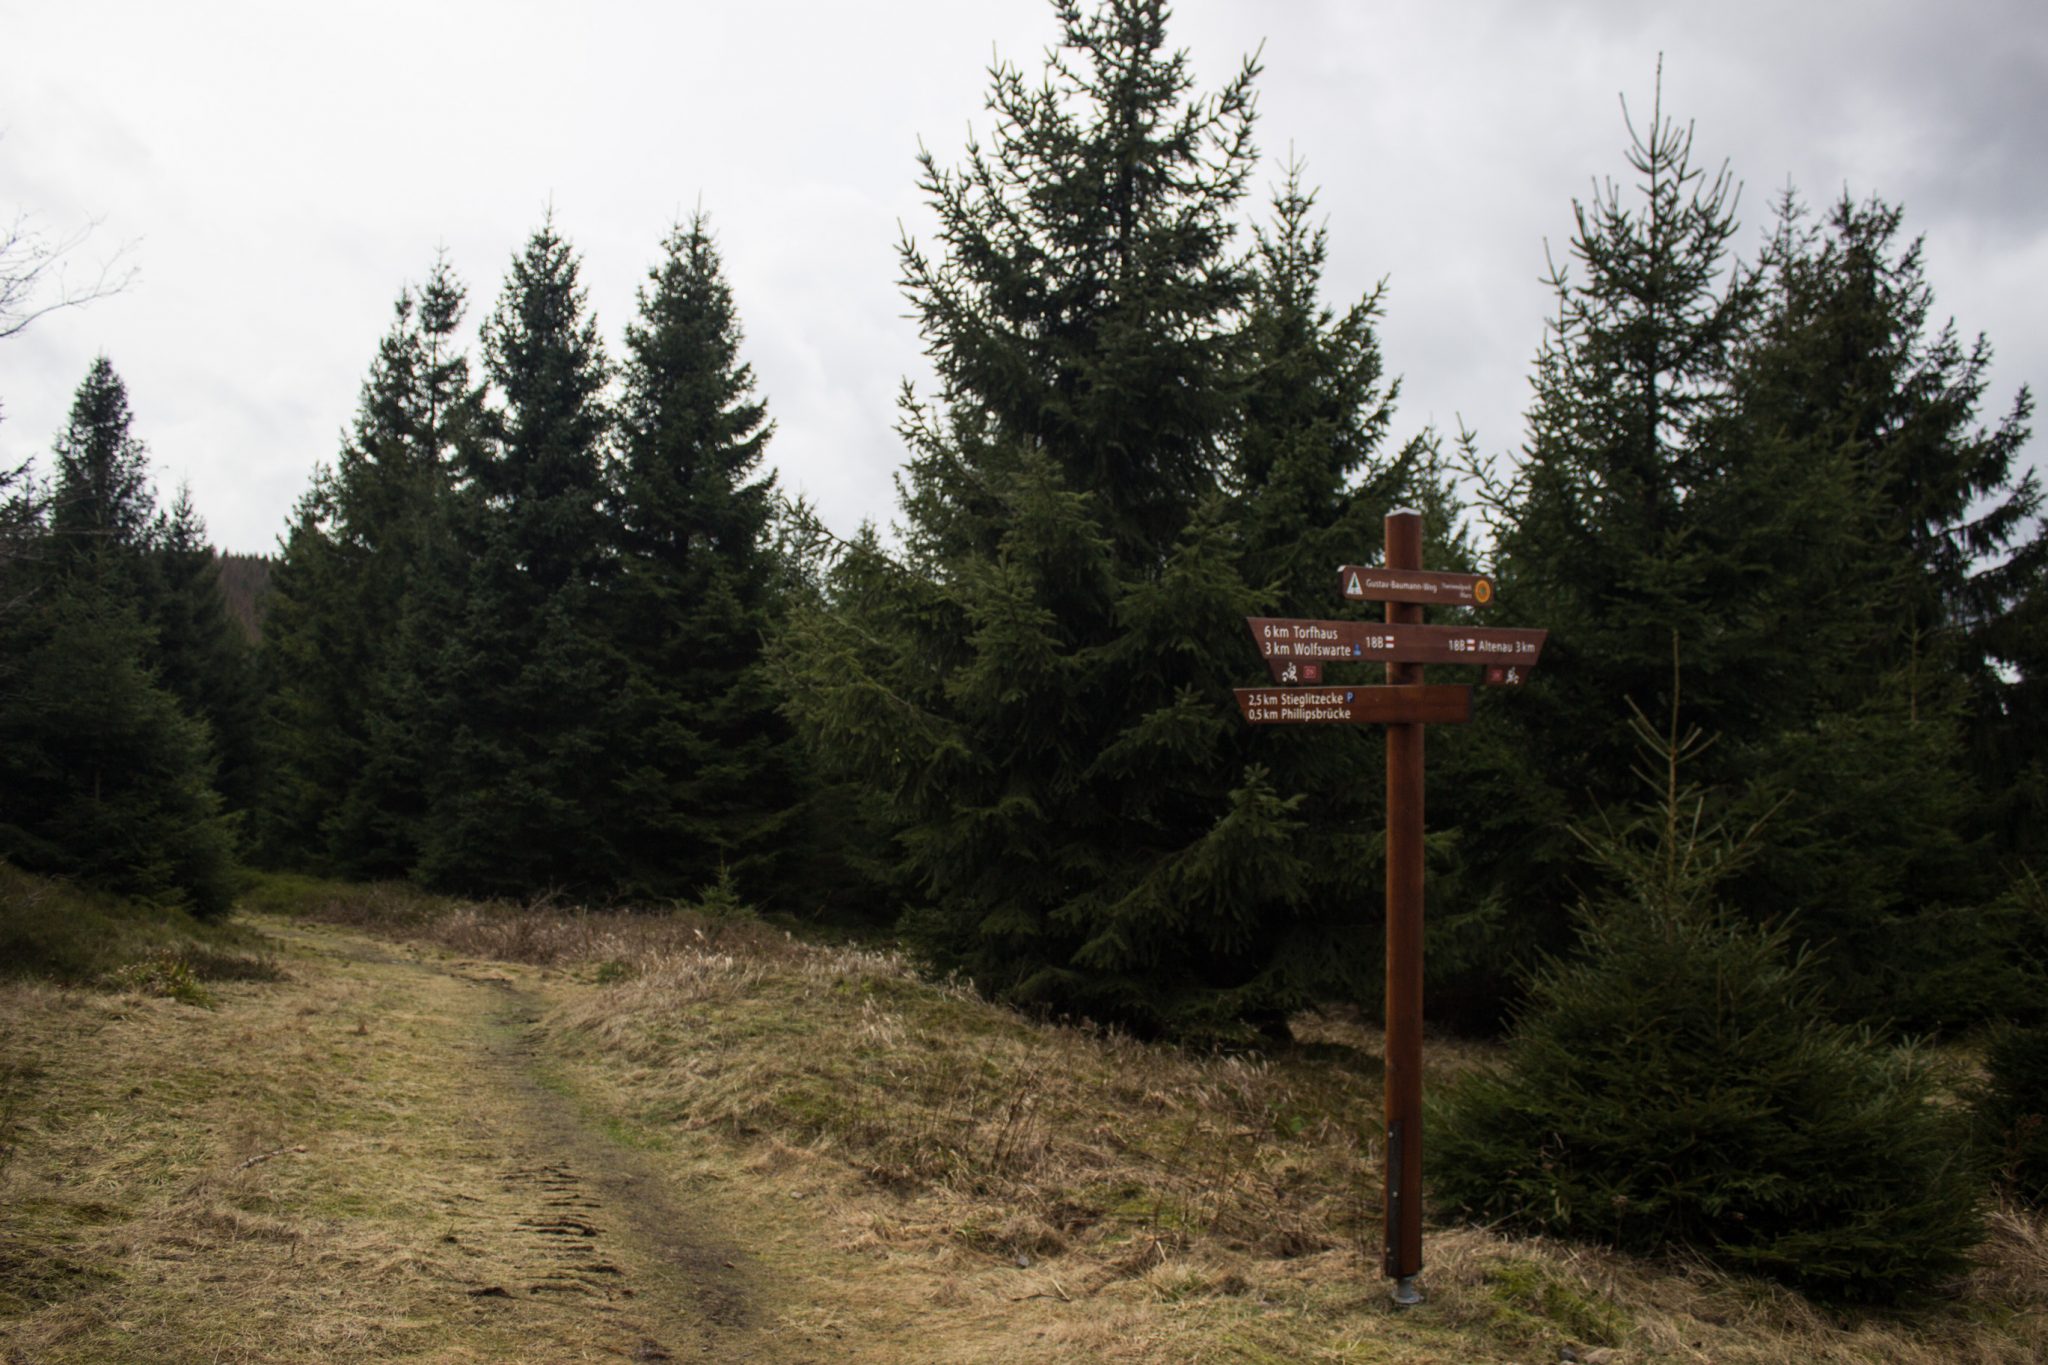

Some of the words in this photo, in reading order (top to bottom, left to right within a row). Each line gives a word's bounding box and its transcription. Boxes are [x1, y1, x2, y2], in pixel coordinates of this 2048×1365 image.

[1264, 625, 1271, 638] 6
[1273, 625, 1289, 638] km
[1293, 625, 1338, 640] Torfhaus
[1265, 642, 1271, 655] 3
[1273, 642, 1290, 655] km
[1294, 642, 1351, 656] Wolfswarte
[1478, 640, 1513, 653] Altenau
[1515, 641, 1521, 653] 3
[1522, 641, 1536, 653] km
[1248, 694, 1262, 706] 2,5
[1263, 694, 1278, 705] km
[1281, 692, 1344, 707] Stieglitzecke
[1248, 709, 1262, 721] 0,5
[1263, 708, 1278, 719] km
[1281, 707, 1351, 722] Phillipsbrücke
